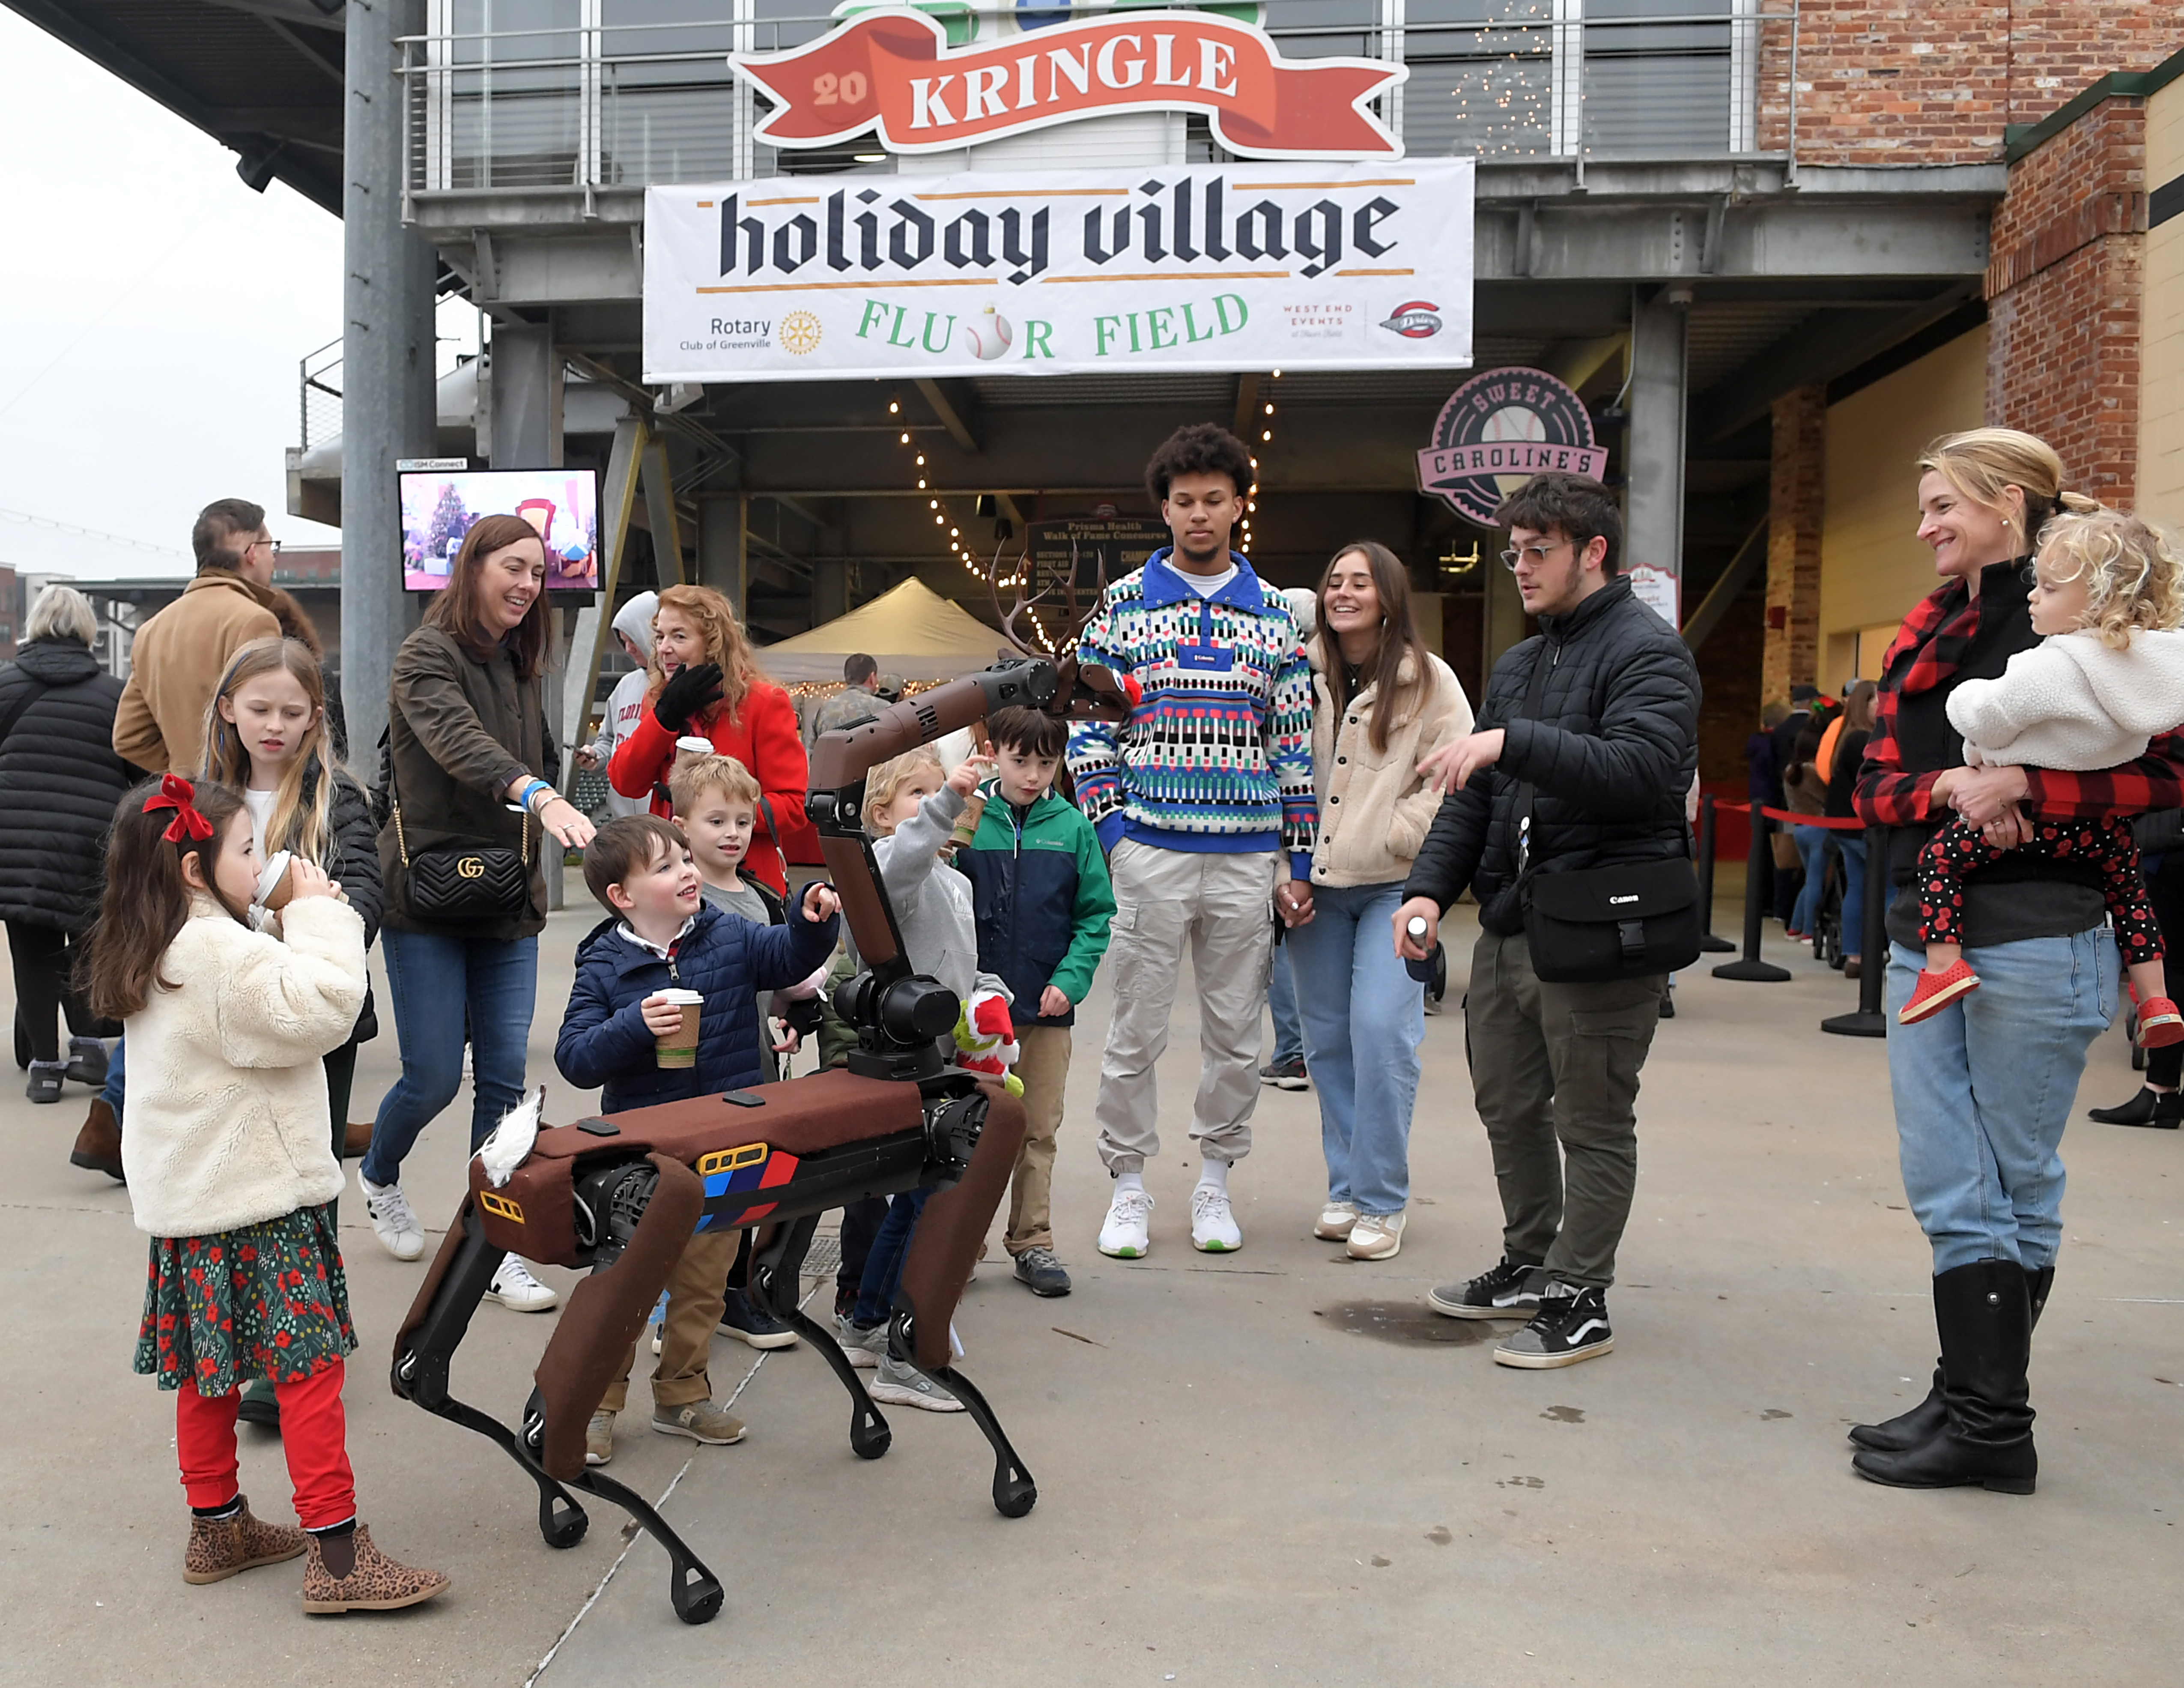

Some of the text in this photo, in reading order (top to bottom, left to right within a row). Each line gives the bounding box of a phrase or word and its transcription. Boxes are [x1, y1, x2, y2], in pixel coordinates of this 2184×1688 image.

[908, 34, 1238, 130] KRINGLE
[720, 175, 1400, 286] holiday village
[711, 318, 771, 336] Rotary
[1094, 293, 1248, 356] FIELD
[1292, 317, 1342, 326] EVENTS
[680, 338, 771, 350] Club of Greenville
[1472, 382, 1556, 412] SWEET
[1435, 448, 1591, 473] CAROLINE'S
[1068, 522, 1142, 530] Prisma Health
[1044, 531, 1167, 540] Walk of Fame Concourse
[1610, 894, 1639, 904] Canon
